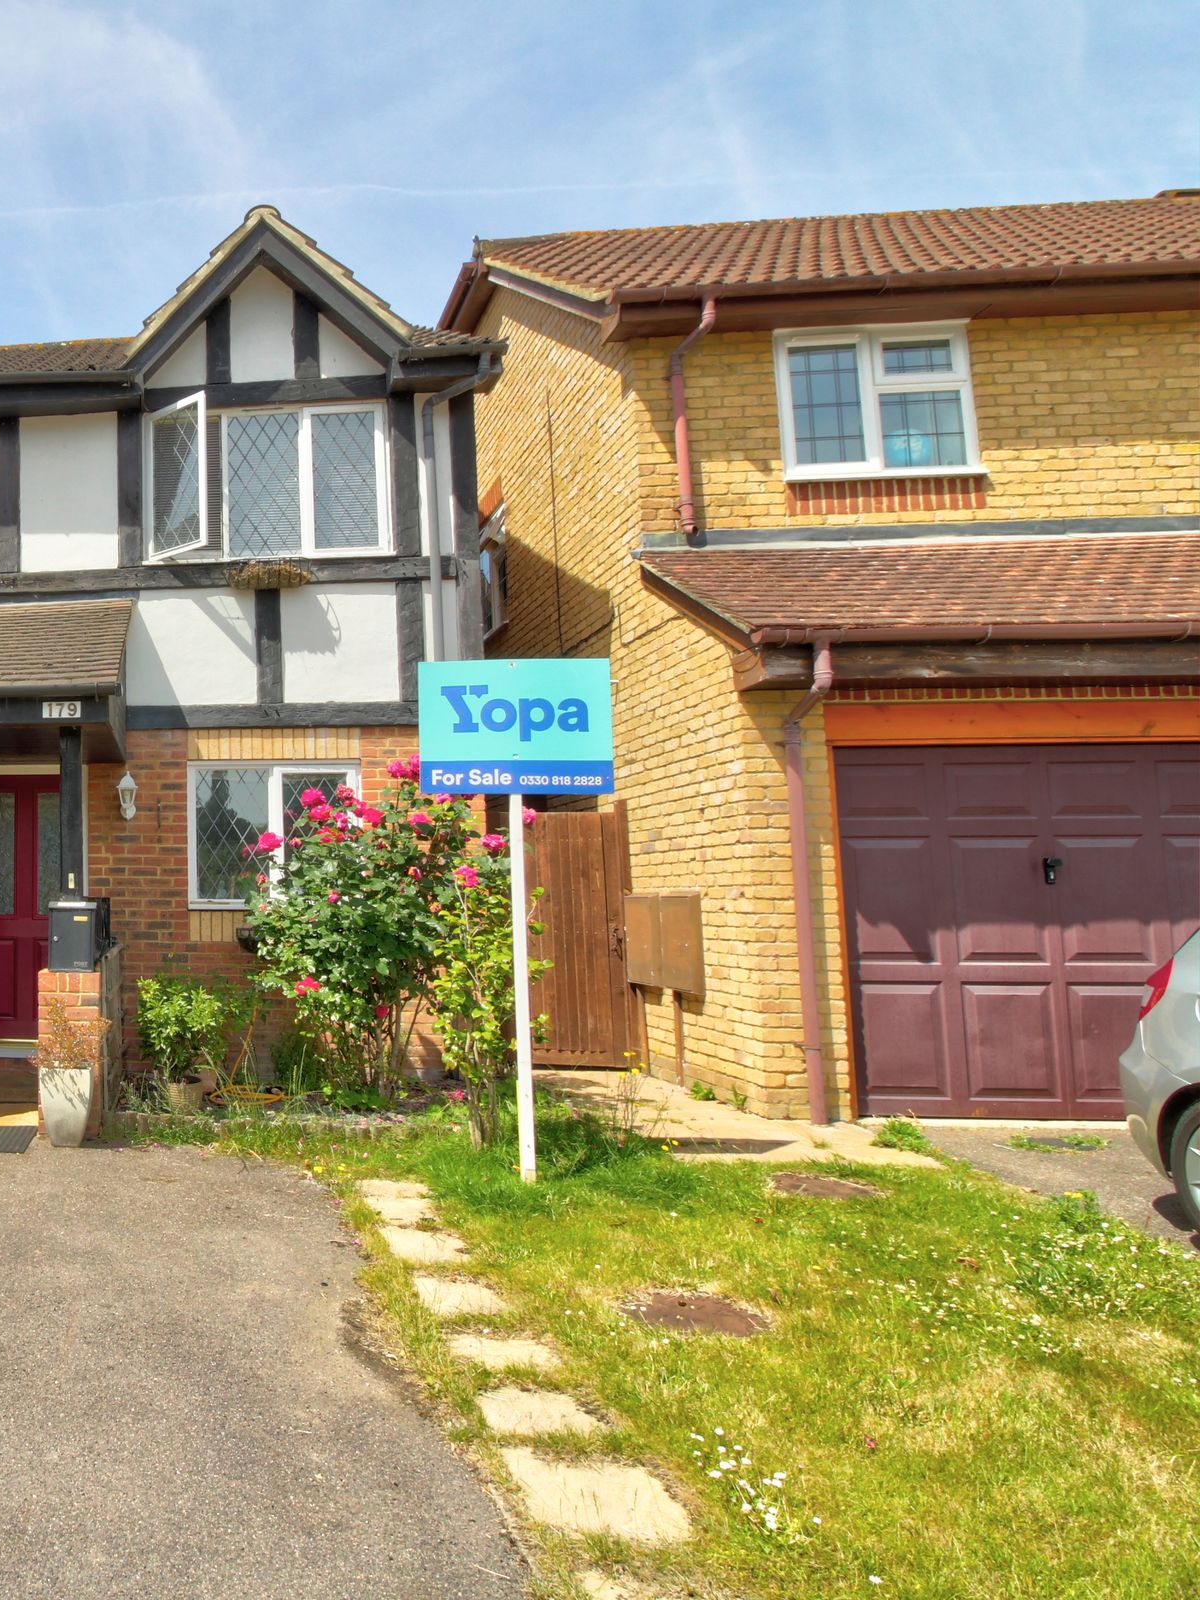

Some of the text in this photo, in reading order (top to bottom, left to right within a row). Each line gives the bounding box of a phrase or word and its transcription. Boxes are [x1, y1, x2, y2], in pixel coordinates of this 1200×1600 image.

[48, 703, 77, 717] 179
[441, 685, 589, 742] Yopa
[431, 768, 602, 786] For Sale 0330 818 2828
